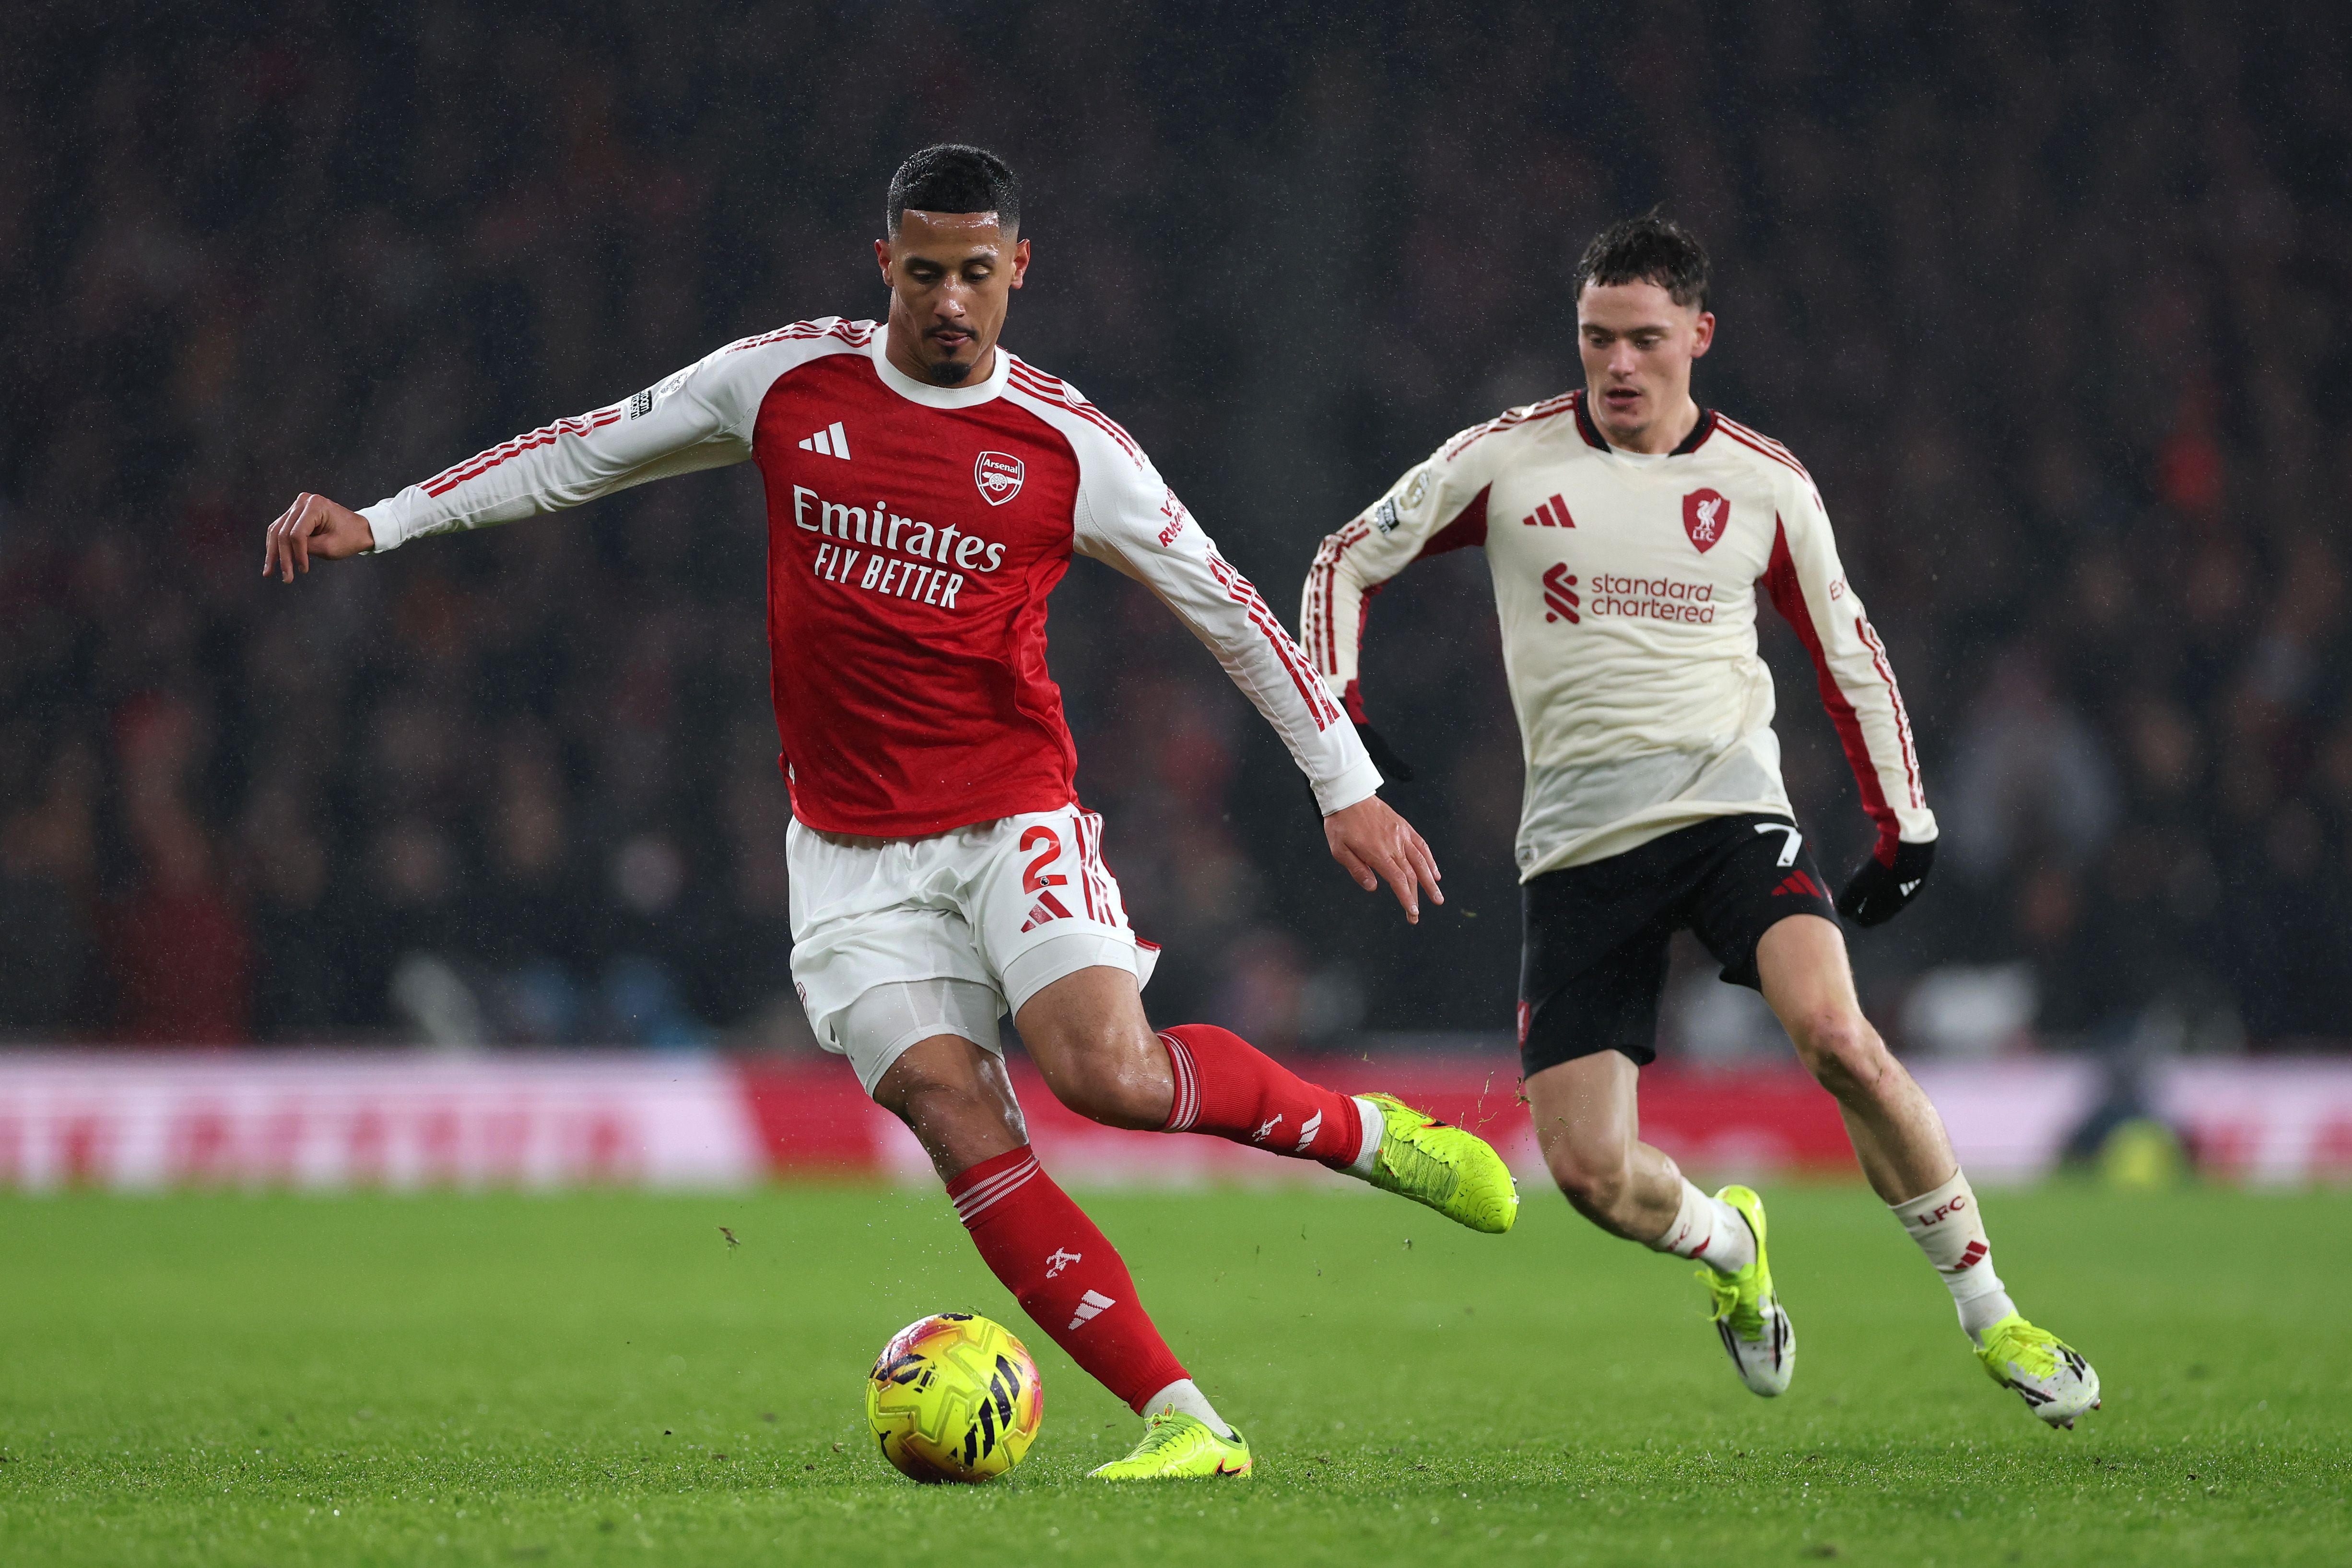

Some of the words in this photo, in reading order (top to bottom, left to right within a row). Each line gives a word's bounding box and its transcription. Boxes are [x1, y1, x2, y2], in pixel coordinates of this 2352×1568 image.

[983, 459, 1018, 474] Arsenal
[793, 484, 1006, 572] Emirates
[1693, 529, 1716, 542] LFC
[814, 542, 860, 584] FLY
[860, 554, 964, 609] BETTER
[1591, 574, 1713, 602] standard
[1591, 595, 1715, 623] chartered
[1020, 825, 1068, 895] 2
[1753, 822, 1802, 867] 7
[1918, 1195, 1965, 1226] LFC
